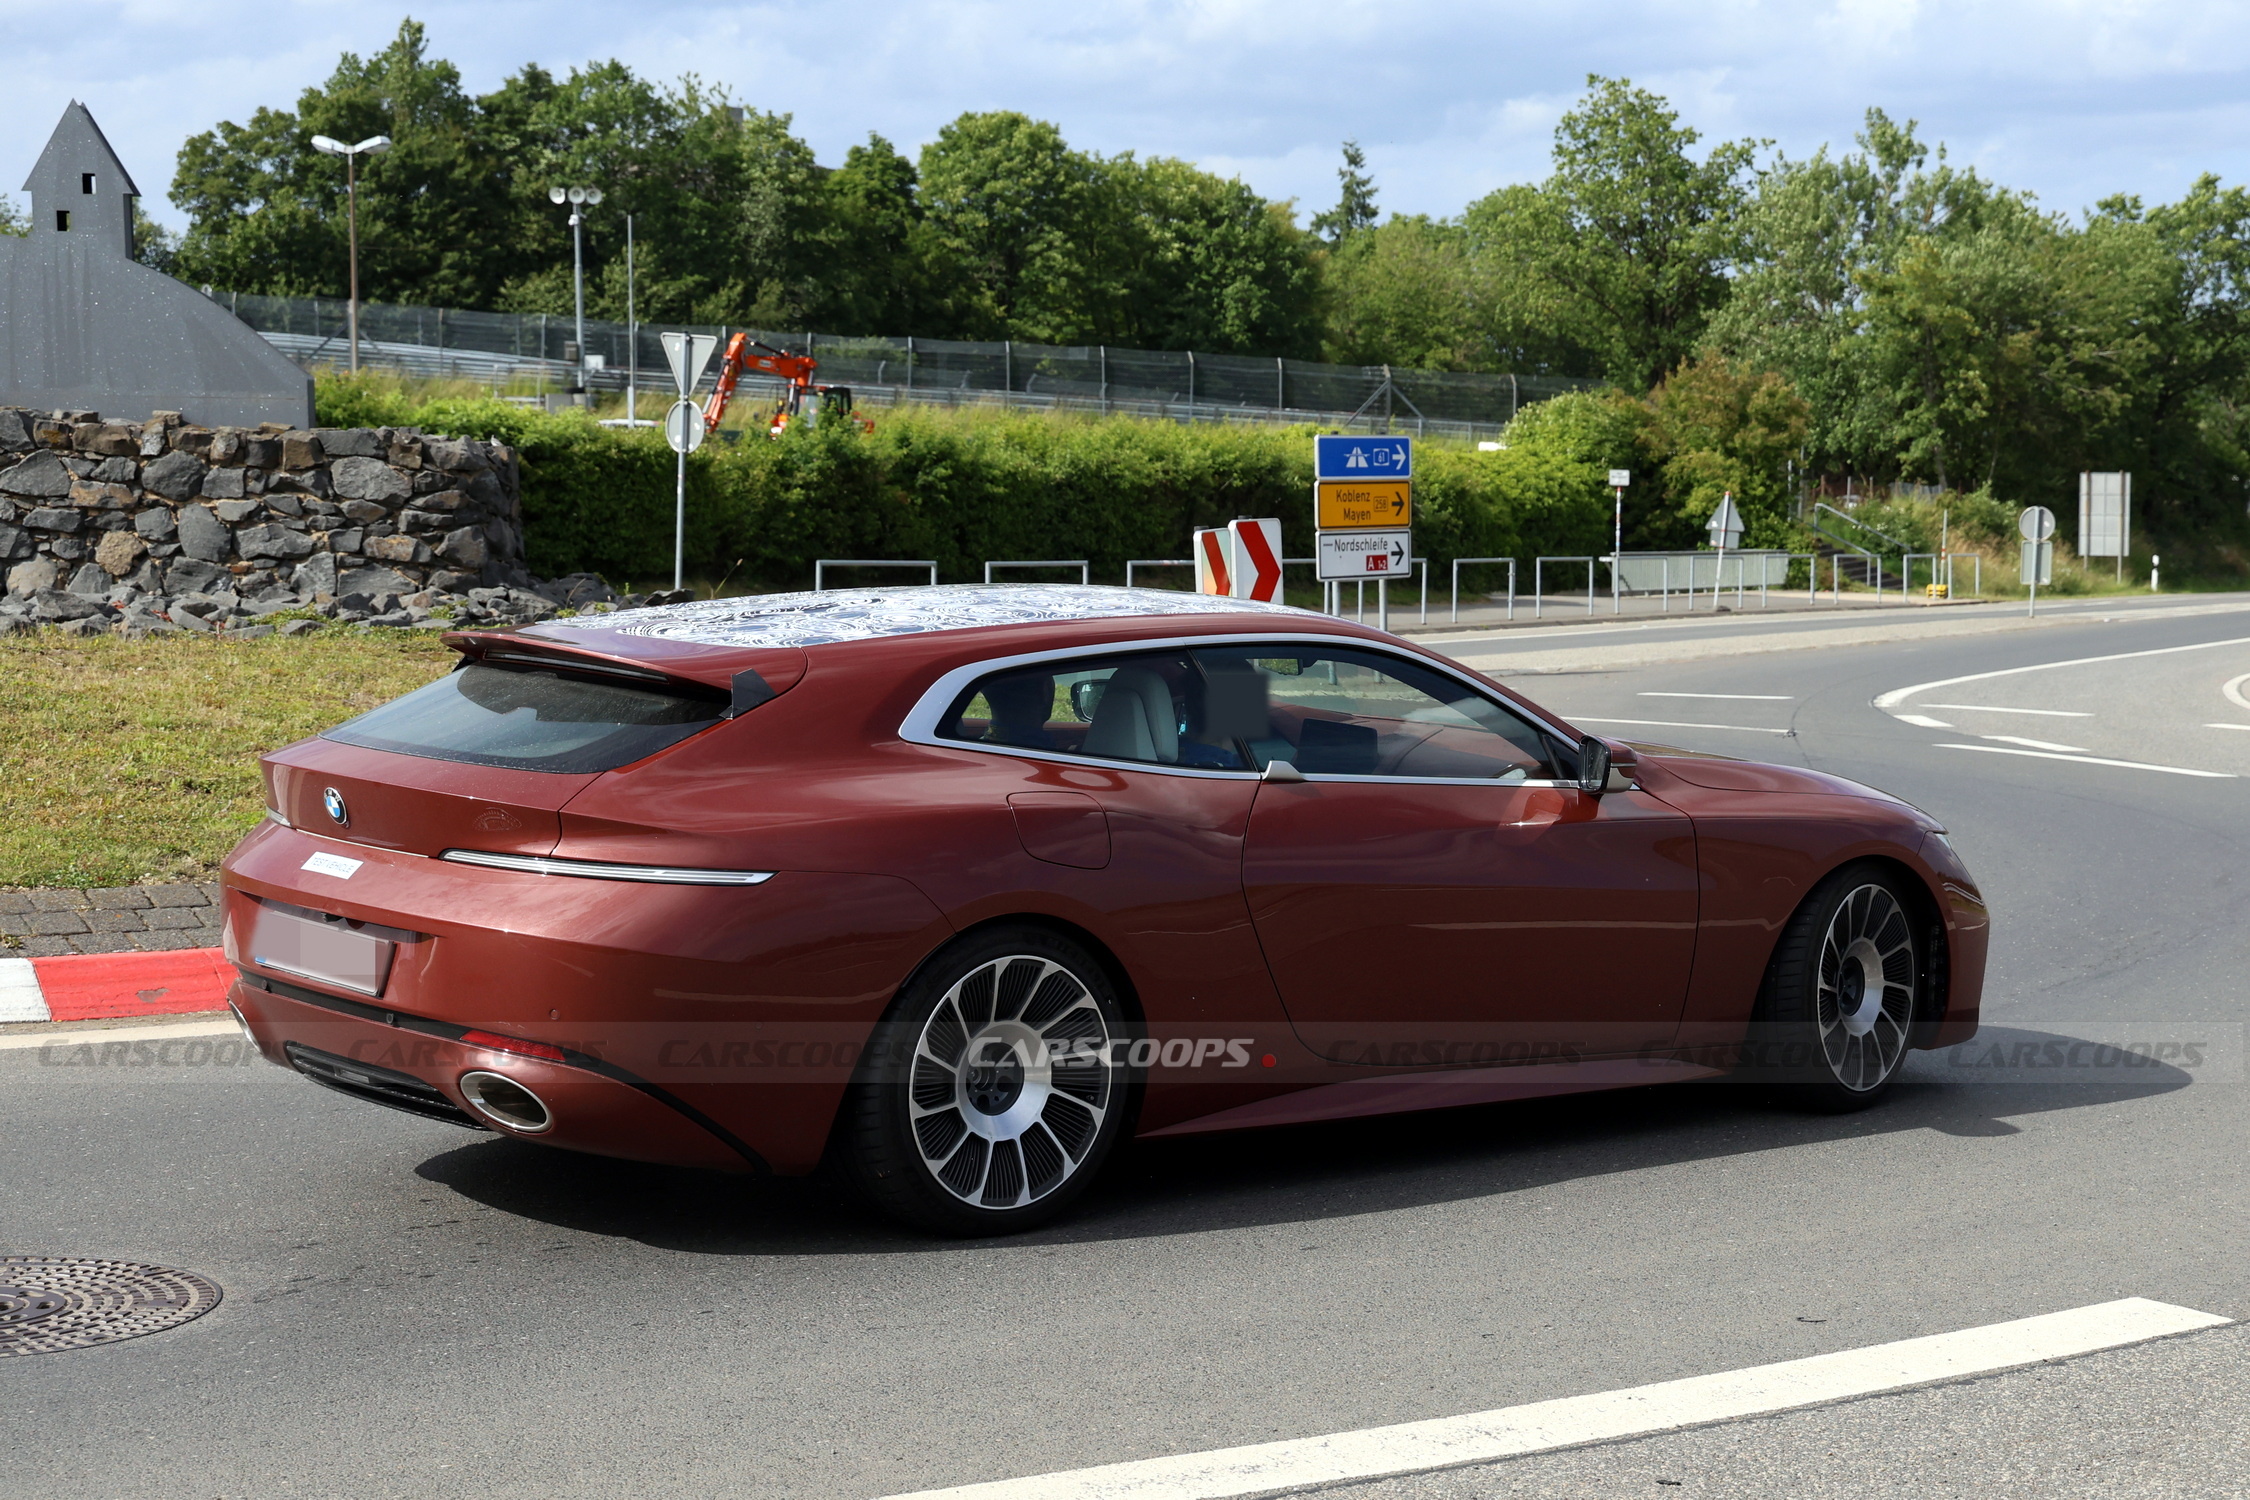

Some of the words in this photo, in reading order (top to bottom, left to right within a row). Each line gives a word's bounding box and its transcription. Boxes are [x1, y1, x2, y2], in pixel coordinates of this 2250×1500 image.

[1336, 489, 1371, 502] Koblenz
[1375, 499, 1387, 509] 258
[1343, 508, 1371, 523] Mayen
[1334, 536, 1388, 552] Nordschleife
[1367, 556, 1375, 570] A
